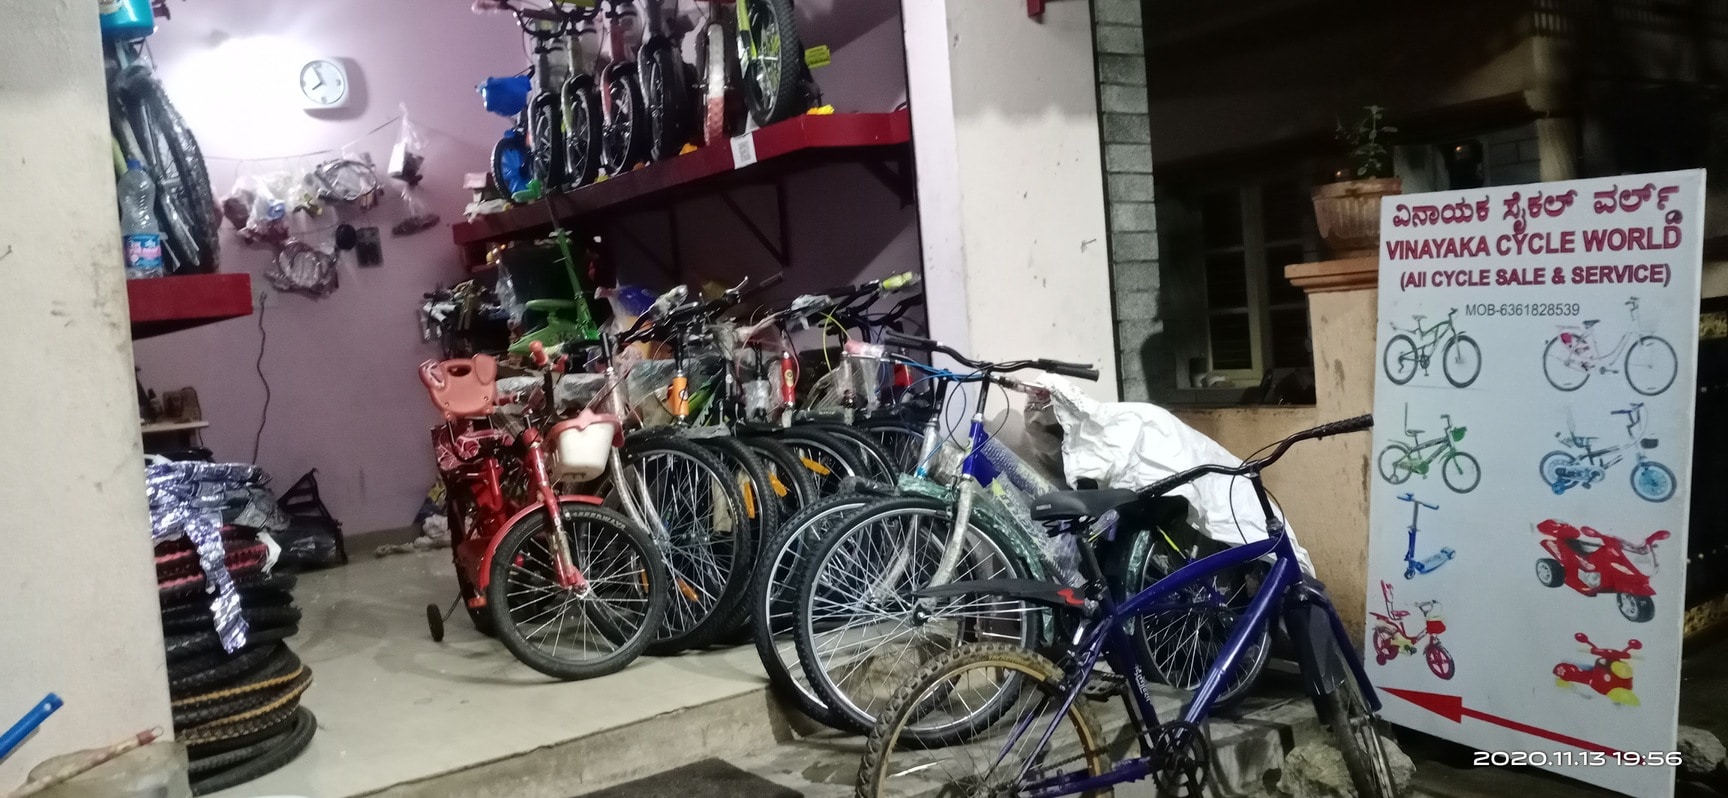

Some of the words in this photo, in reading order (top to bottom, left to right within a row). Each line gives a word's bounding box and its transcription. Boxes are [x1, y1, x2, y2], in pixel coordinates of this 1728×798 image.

[1392, 194, 1490, 228] ವಿನಾಯಕ
[1503, 189, 1578, 235] ಸೈಕಲ್
[1385, 236, 1491, 260] VINAYAKA
[1496, 230, 1576, 256] CYCLE
[1582, 224, 1683, 252] WORLD
[1431, 269, 1491, 288] CYCLE
[1495, 267, 1546, 287] SALE
[1551, 266, 1566, 285] &
[1571, 263, 1672, 288] SERVICE)
[1465, 302, 1581, 316] MOB-6361828539
